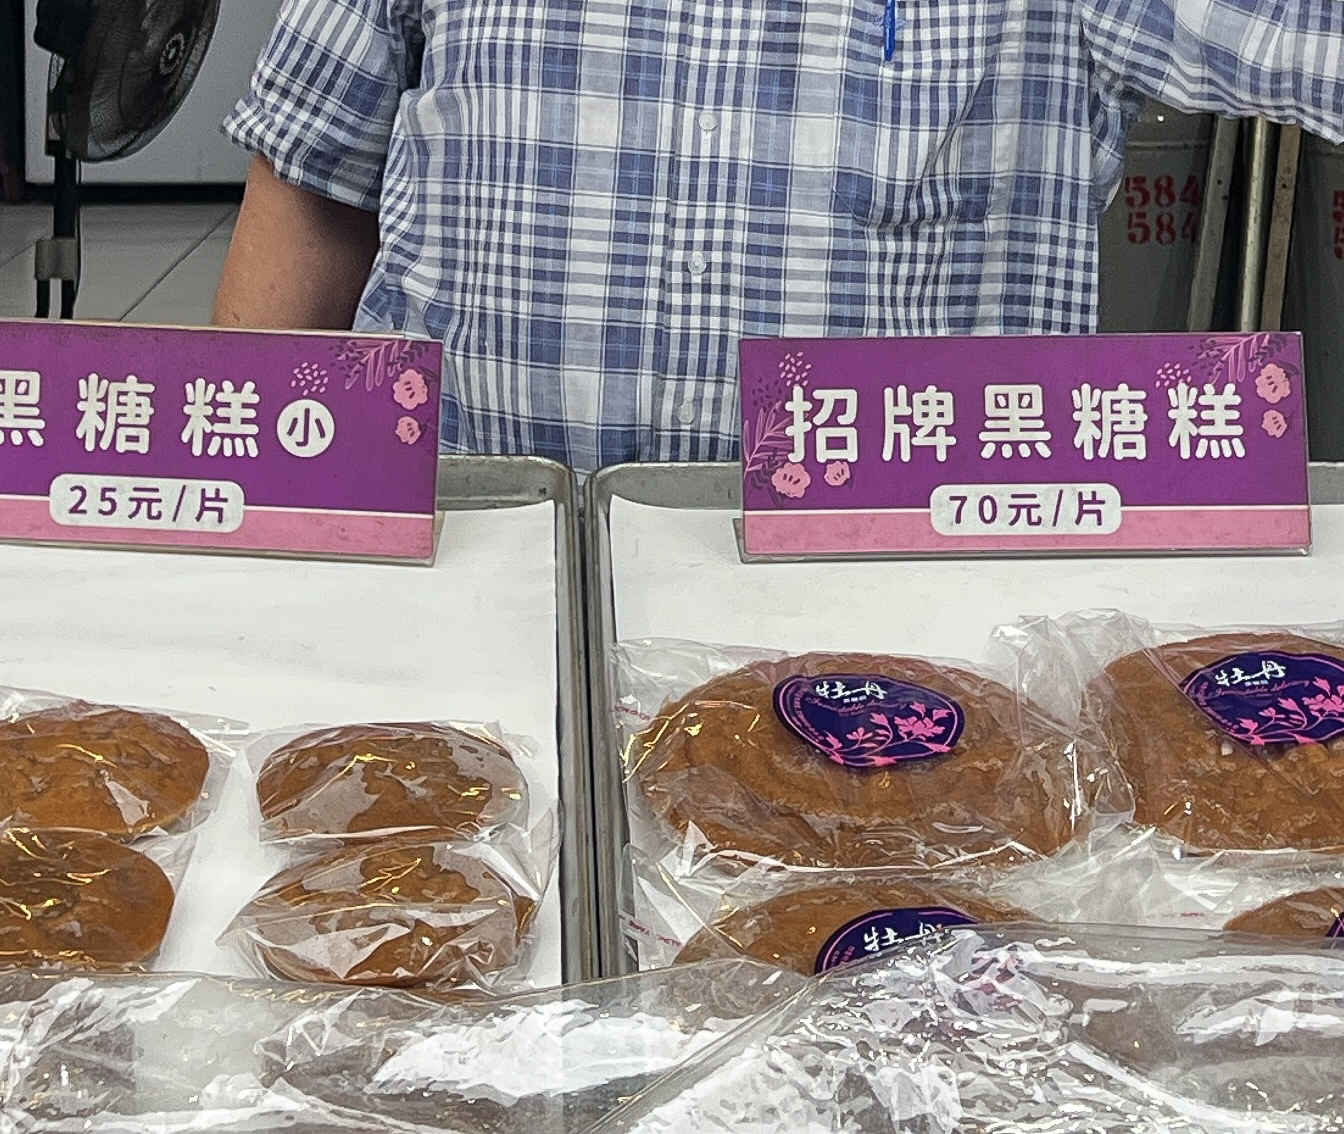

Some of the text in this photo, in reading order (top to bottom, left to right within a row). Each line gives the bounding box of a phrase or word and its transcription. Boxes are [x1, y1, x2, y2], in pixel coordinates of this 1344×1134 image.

[784, 381, 1246, 465] 招牌黑糖糕
[67, 483, 229, 525] 25元/片
[948, 489, 1107, 527] 70元/片
